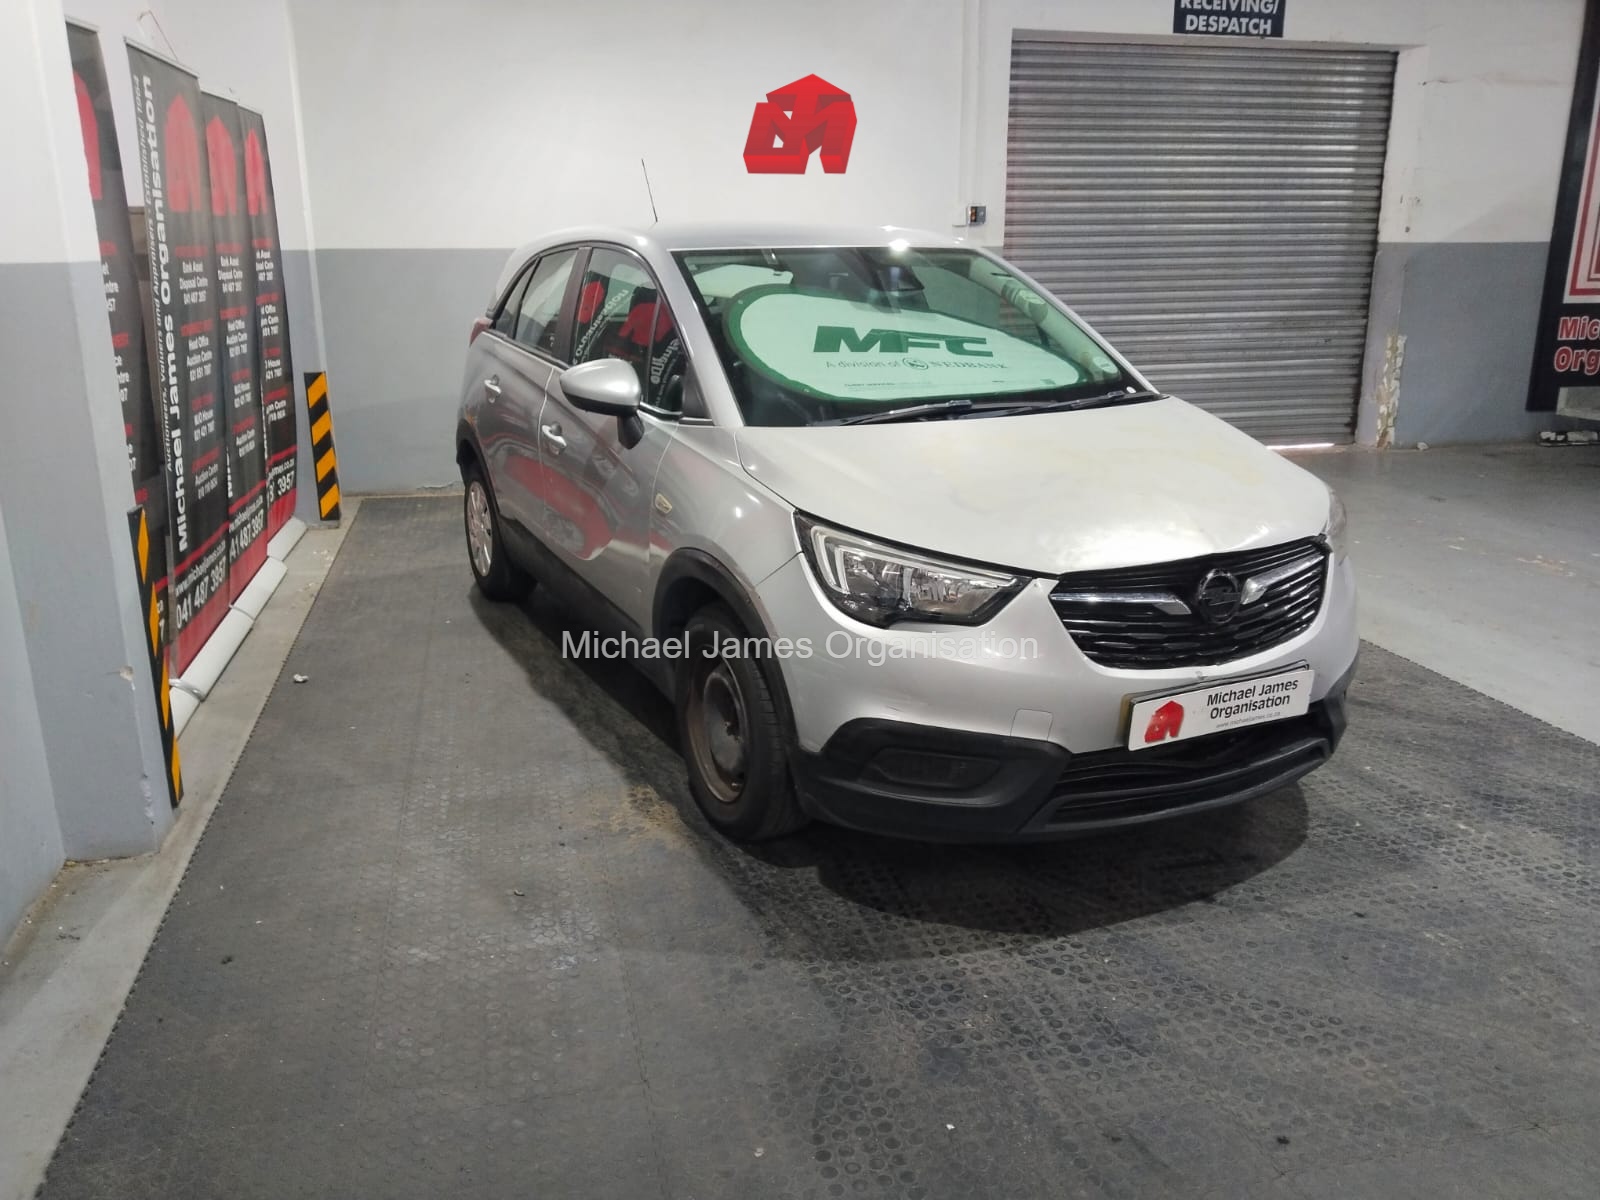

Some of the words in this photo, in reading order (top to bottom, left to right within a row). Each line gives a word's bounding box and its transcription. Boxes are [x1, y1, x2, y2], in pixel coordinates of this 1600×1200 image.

[1180, 0, 1279, 14] RECEIVING/
[1185, 14, 1272, 35] DESPATCH
[142, 75, 171, 304] Organisation
[813, 325, 993, 358] MFC
[163, 313, 180, 420] James
[171, 428, 188, 552] Michael
[176, 592, 192, 629] 041
[194, 575, 209, 609] 487
[1206, 685, 1256, 707] Michael
[1258, 679, 1299, 697] James
[1209, 694, 1291, 720] Organisation
